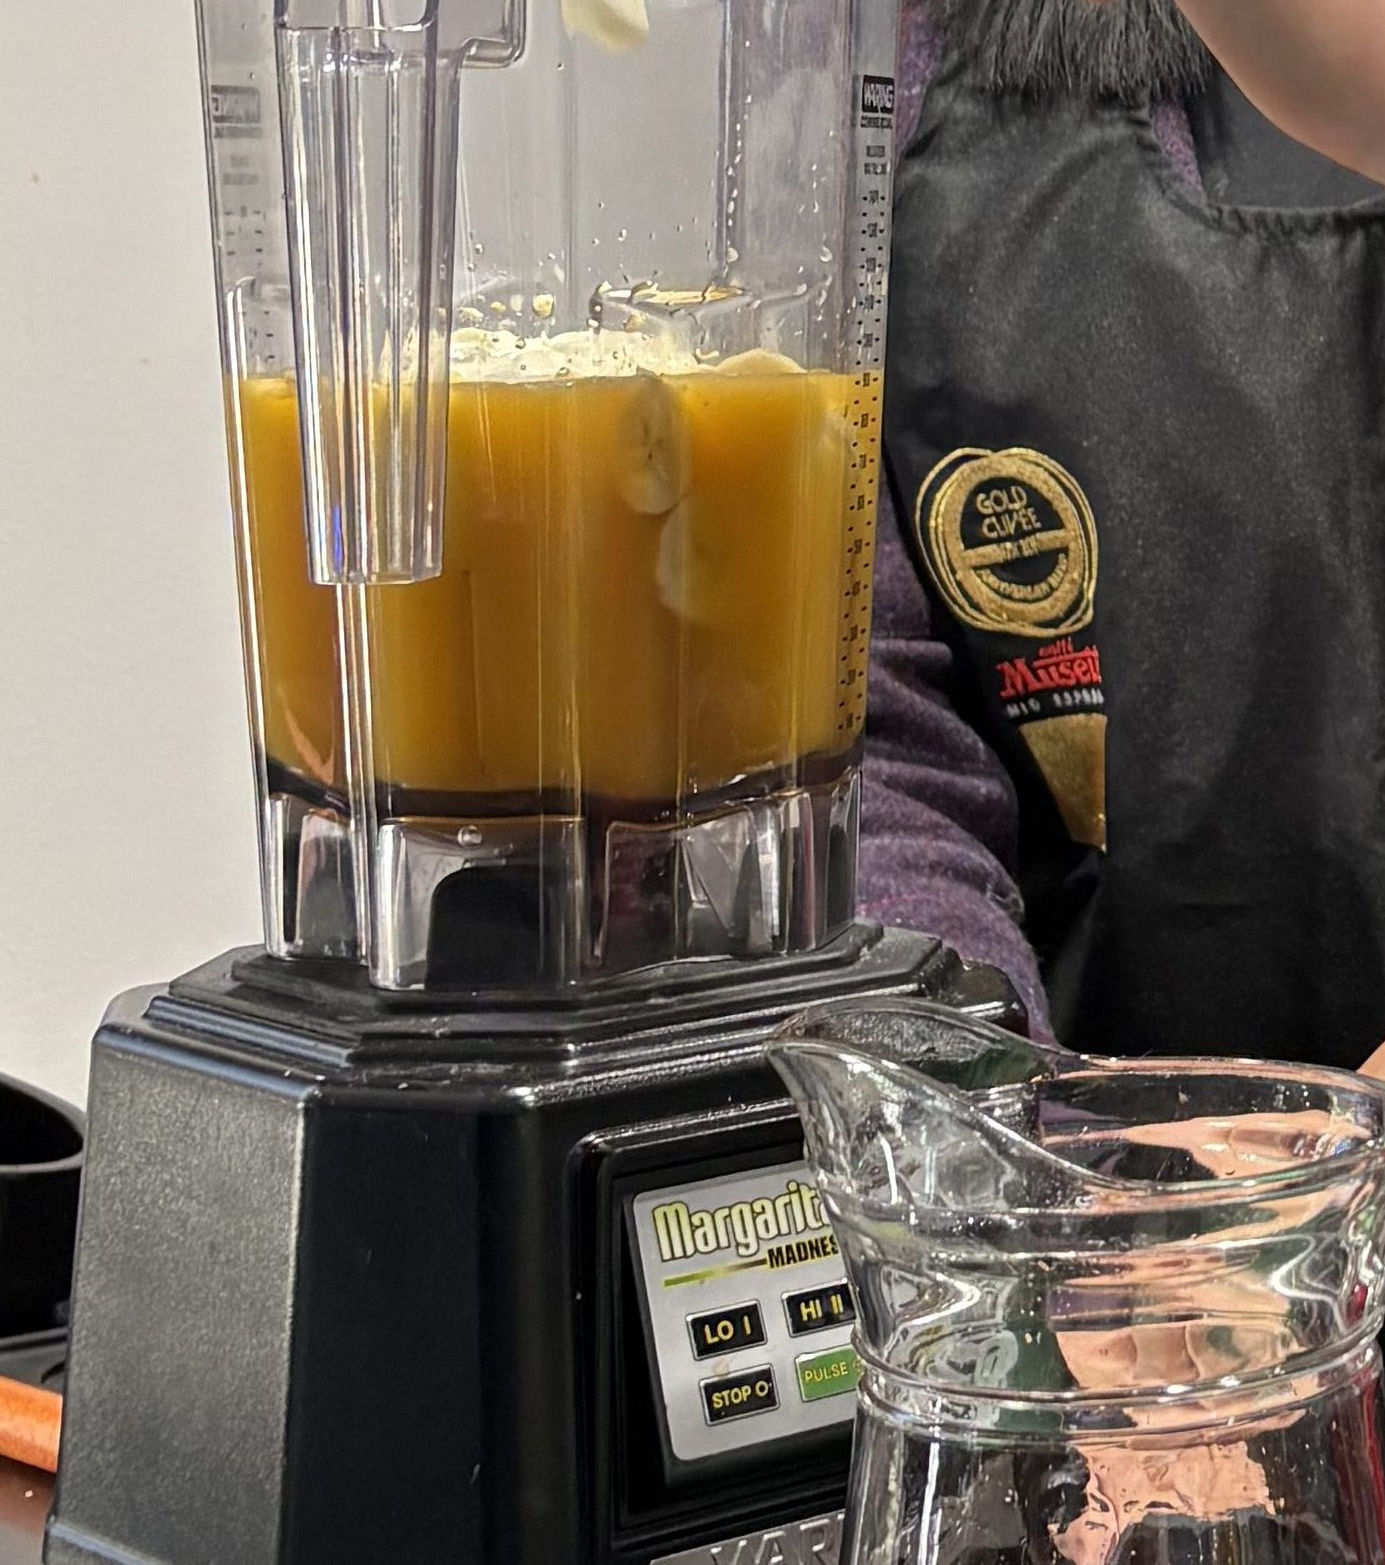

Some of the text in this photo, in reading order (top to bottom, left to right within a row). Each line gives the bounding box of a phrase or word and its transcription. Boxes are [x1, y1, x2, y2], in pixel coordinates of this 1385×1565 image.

[976, 485, 1027, 515] GOLD
[767, 1234, 839, 1269] MADNES
[800, 1299, 822, 1322] HI
[704, 1320, 734, 1344] LO
[804, 1362, 849, 1384] PULSE
[711, 1385, 751, 1410] STOP
